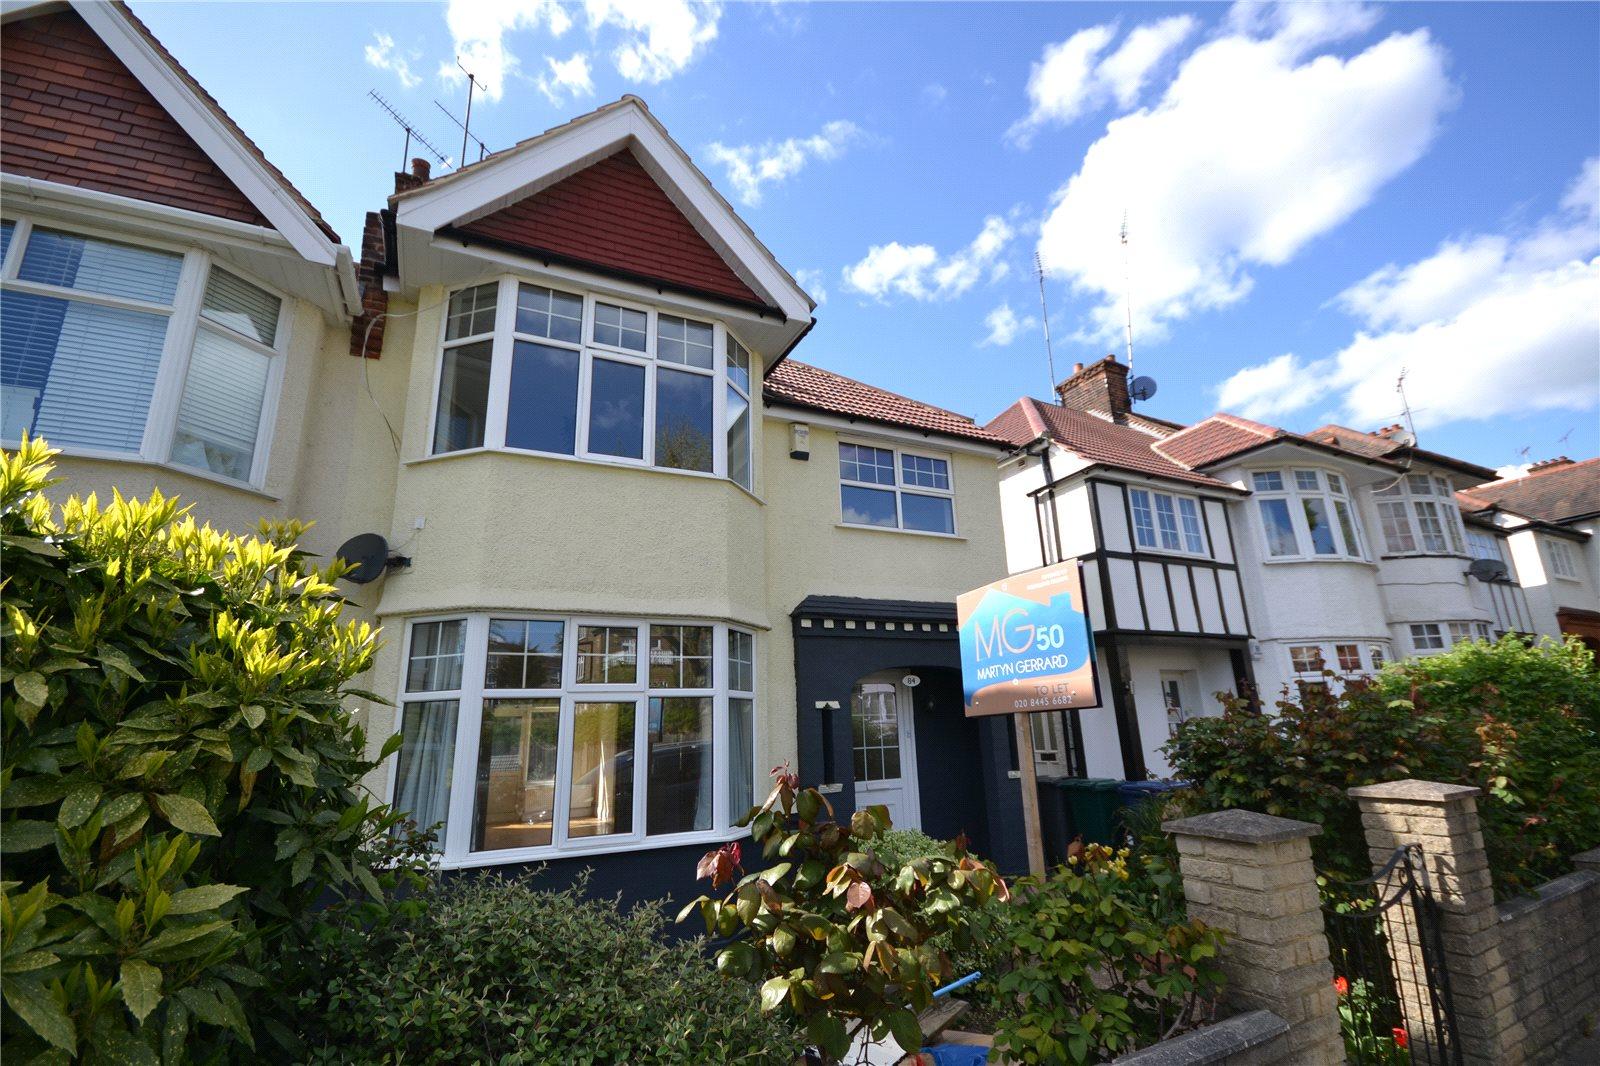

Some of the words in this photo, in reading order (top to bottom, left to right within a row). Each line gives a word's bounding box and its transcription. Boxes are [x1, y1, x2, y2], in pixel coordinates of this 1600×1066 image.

[975, 608, 1035, 662] MG
[1036, 624, 1065, 651] 50
[977, 662, 1014, 681] MARTYN
[1015, 654, 1068, 674] GERRARD
[907, 677, 916, 685] 84
[1034, 685, 1049, 696] TO
[1051, 682, 1069, 694] LET
[1014, 699, 1028, 708] 020
[1030, 696, 1050, 707] 8445
[1052, 695, 1073, 705] 6682
